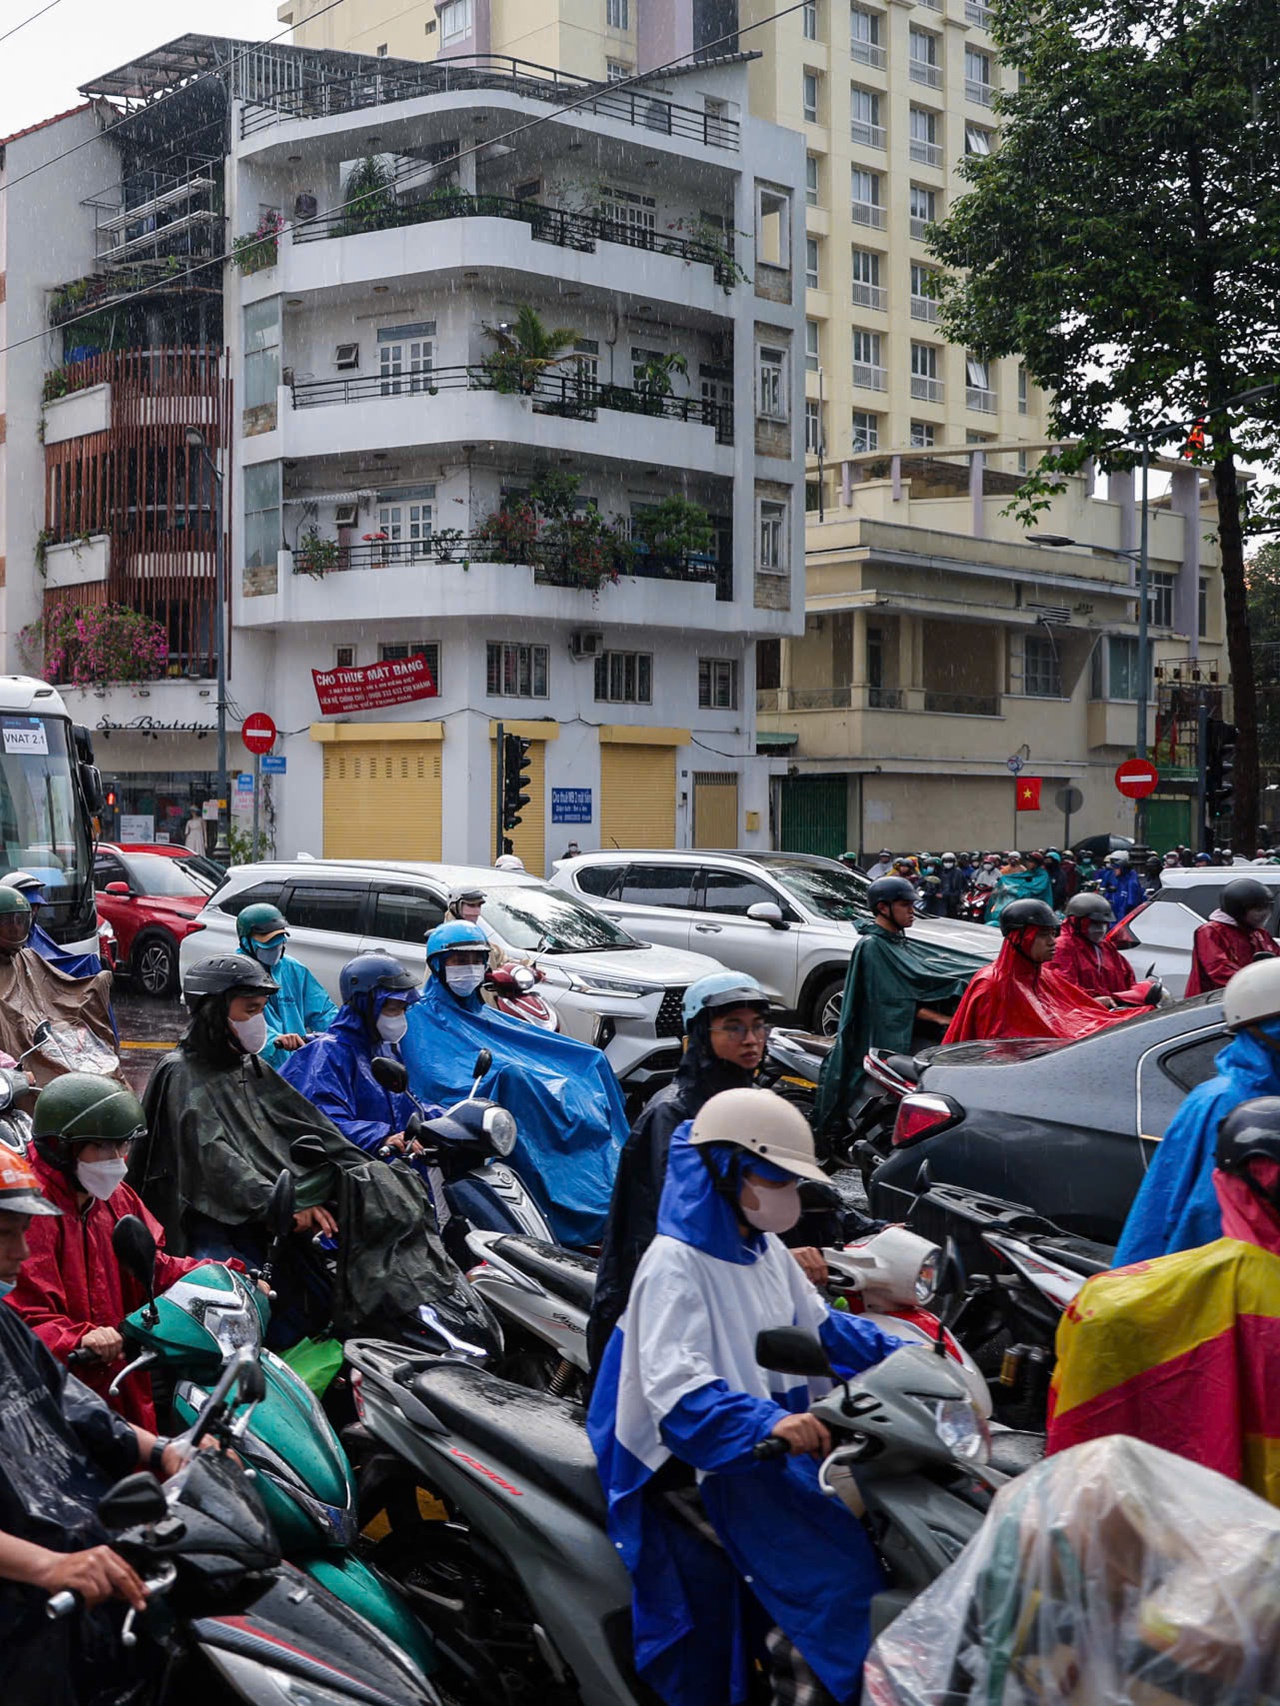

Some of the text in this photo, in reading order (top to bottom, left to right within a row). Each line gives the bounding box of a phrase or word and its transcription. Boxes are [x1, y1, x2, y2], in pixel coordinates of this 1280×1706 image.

[316, 674, 336, 686] CHO
[3, 733, 45, 745] VNAT 2.1
